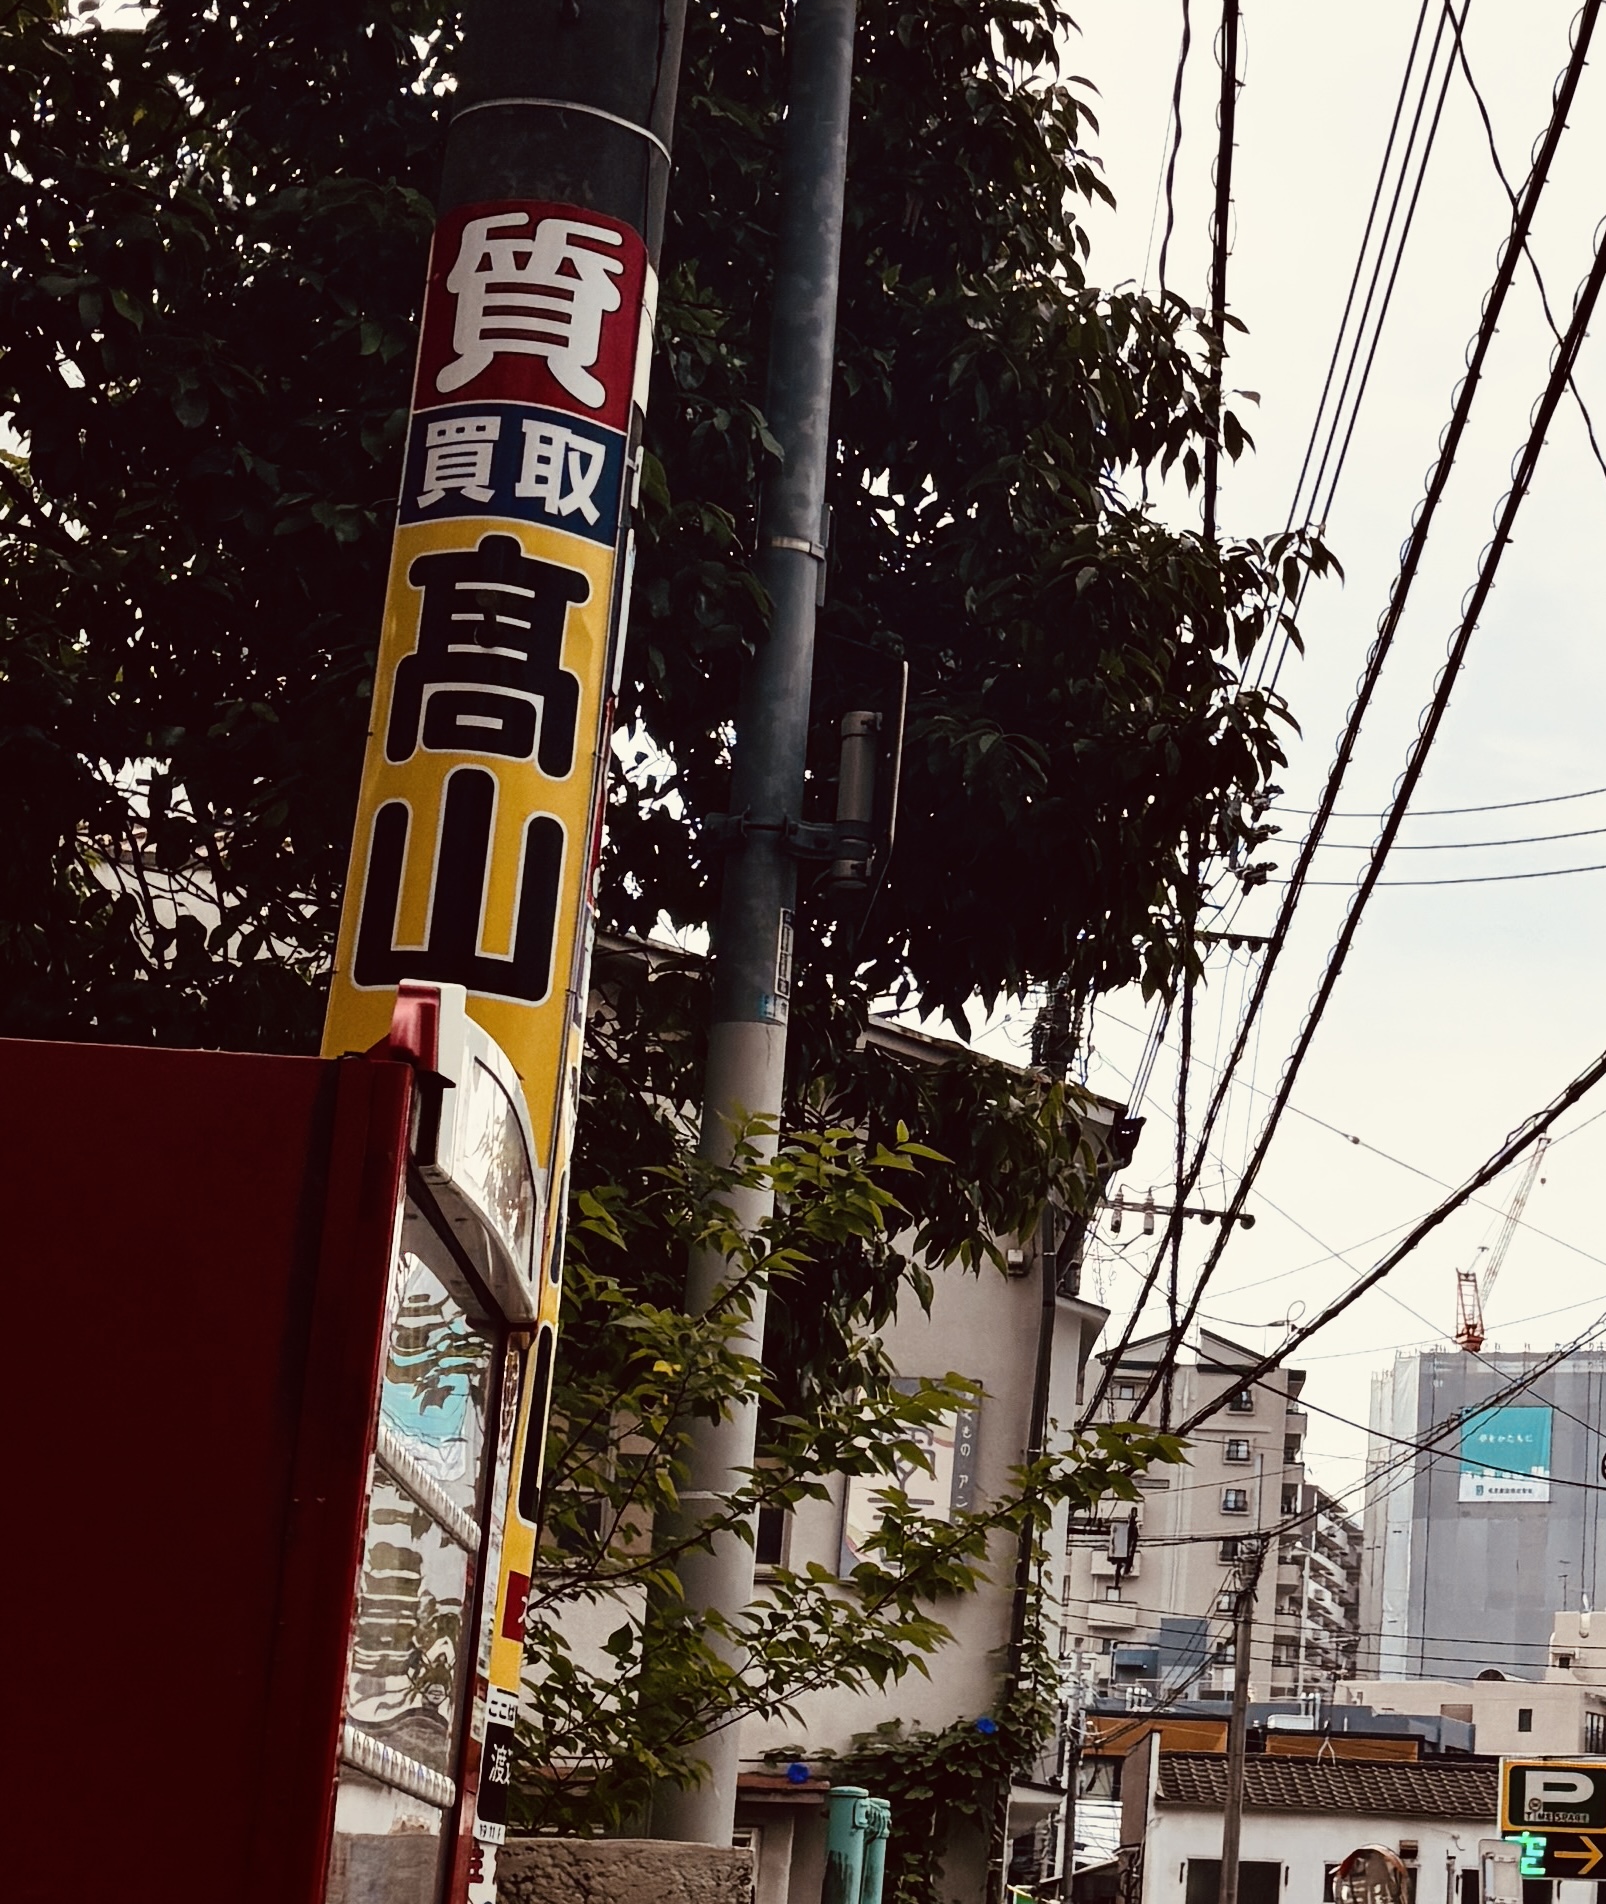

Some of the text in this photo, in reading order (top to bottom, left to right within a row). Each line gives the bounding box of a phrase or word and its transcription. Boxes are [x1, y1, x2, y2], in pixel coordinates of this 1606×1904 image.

[436, 211, 624, 410] 質
[416, 415, 607, 524] 買取
[1524, 1770, 1595, 1816] P
